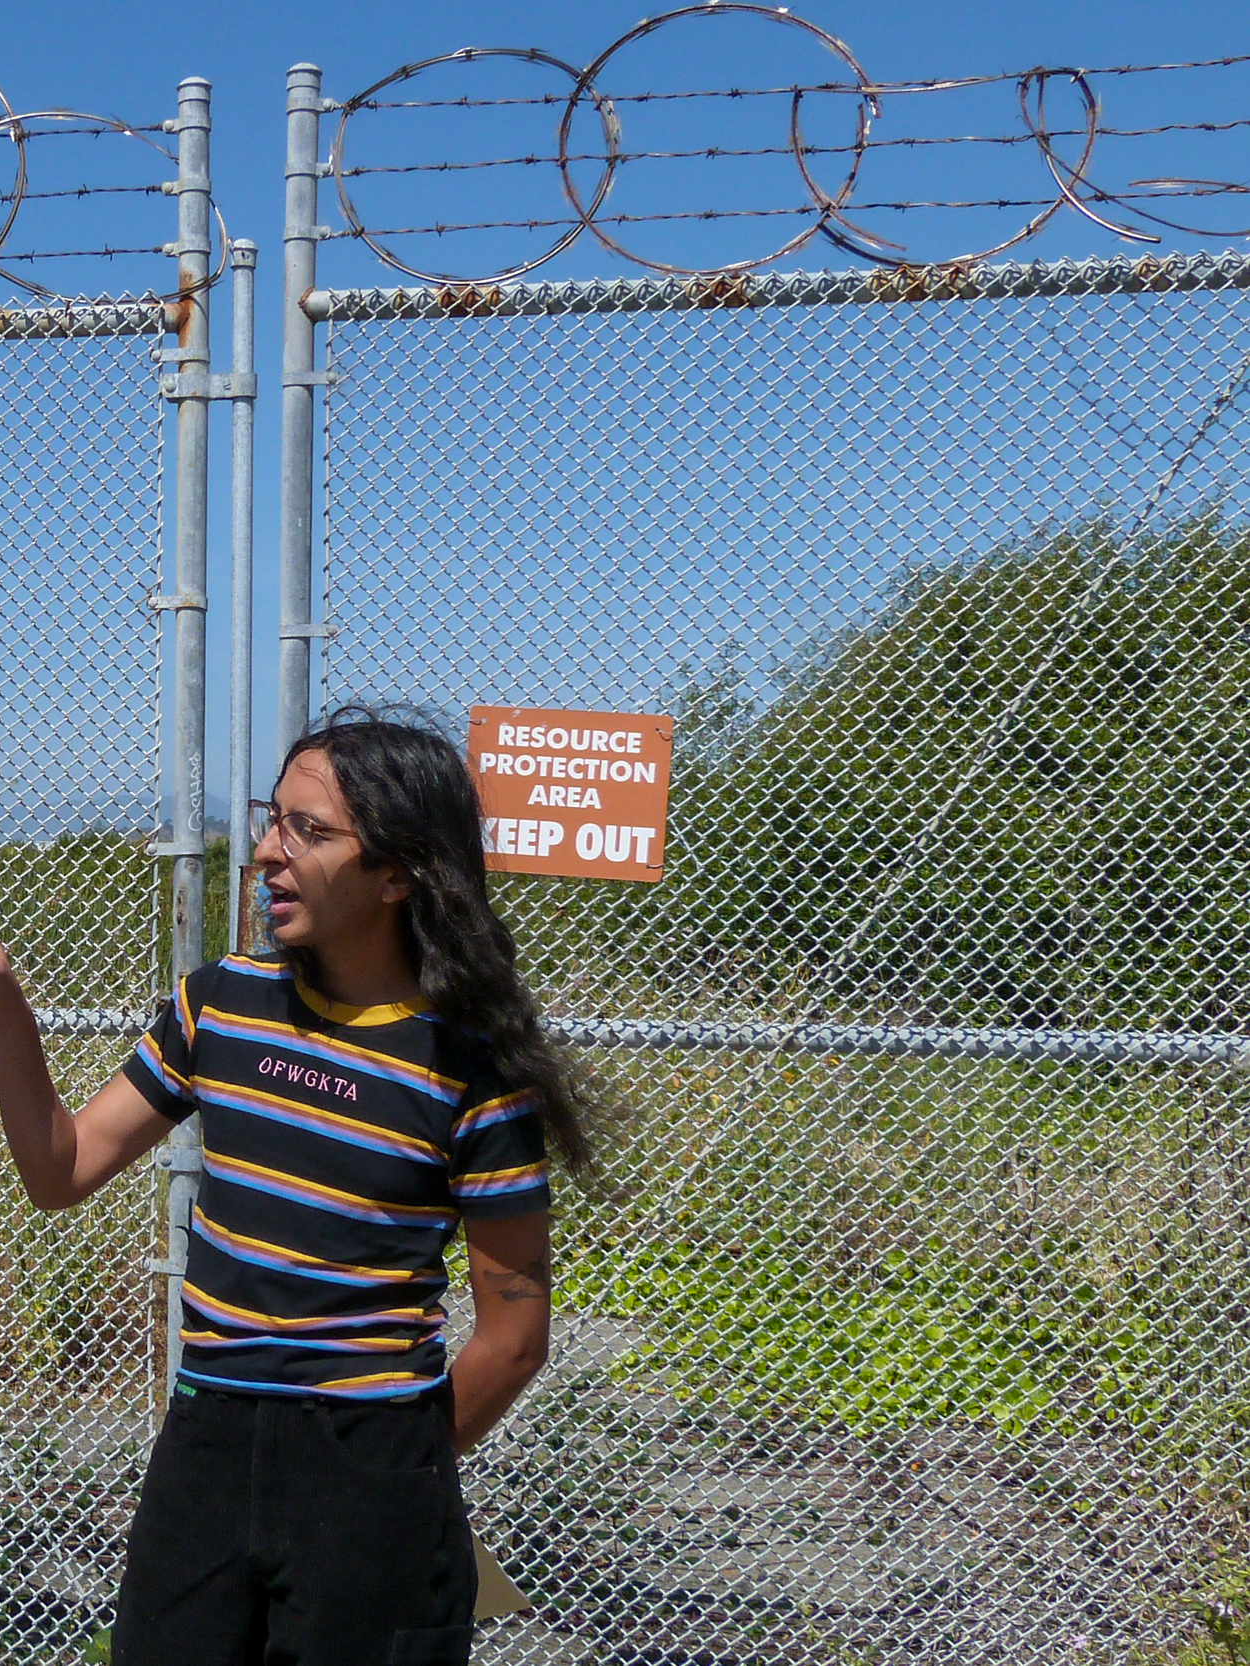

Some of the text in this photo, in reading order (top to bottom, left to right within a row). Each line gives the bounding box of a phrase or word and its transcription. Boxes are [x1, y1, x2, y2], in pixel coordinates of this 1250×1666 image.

[498, 725, 642, 754] RESOURCE
[479, 753, 656, 783] PROTECTION
[527, 785, 602, 809] AREA
[575, 823, 656, 864] OUT
[258, 1057, 357, 1101] OFWGKTA
